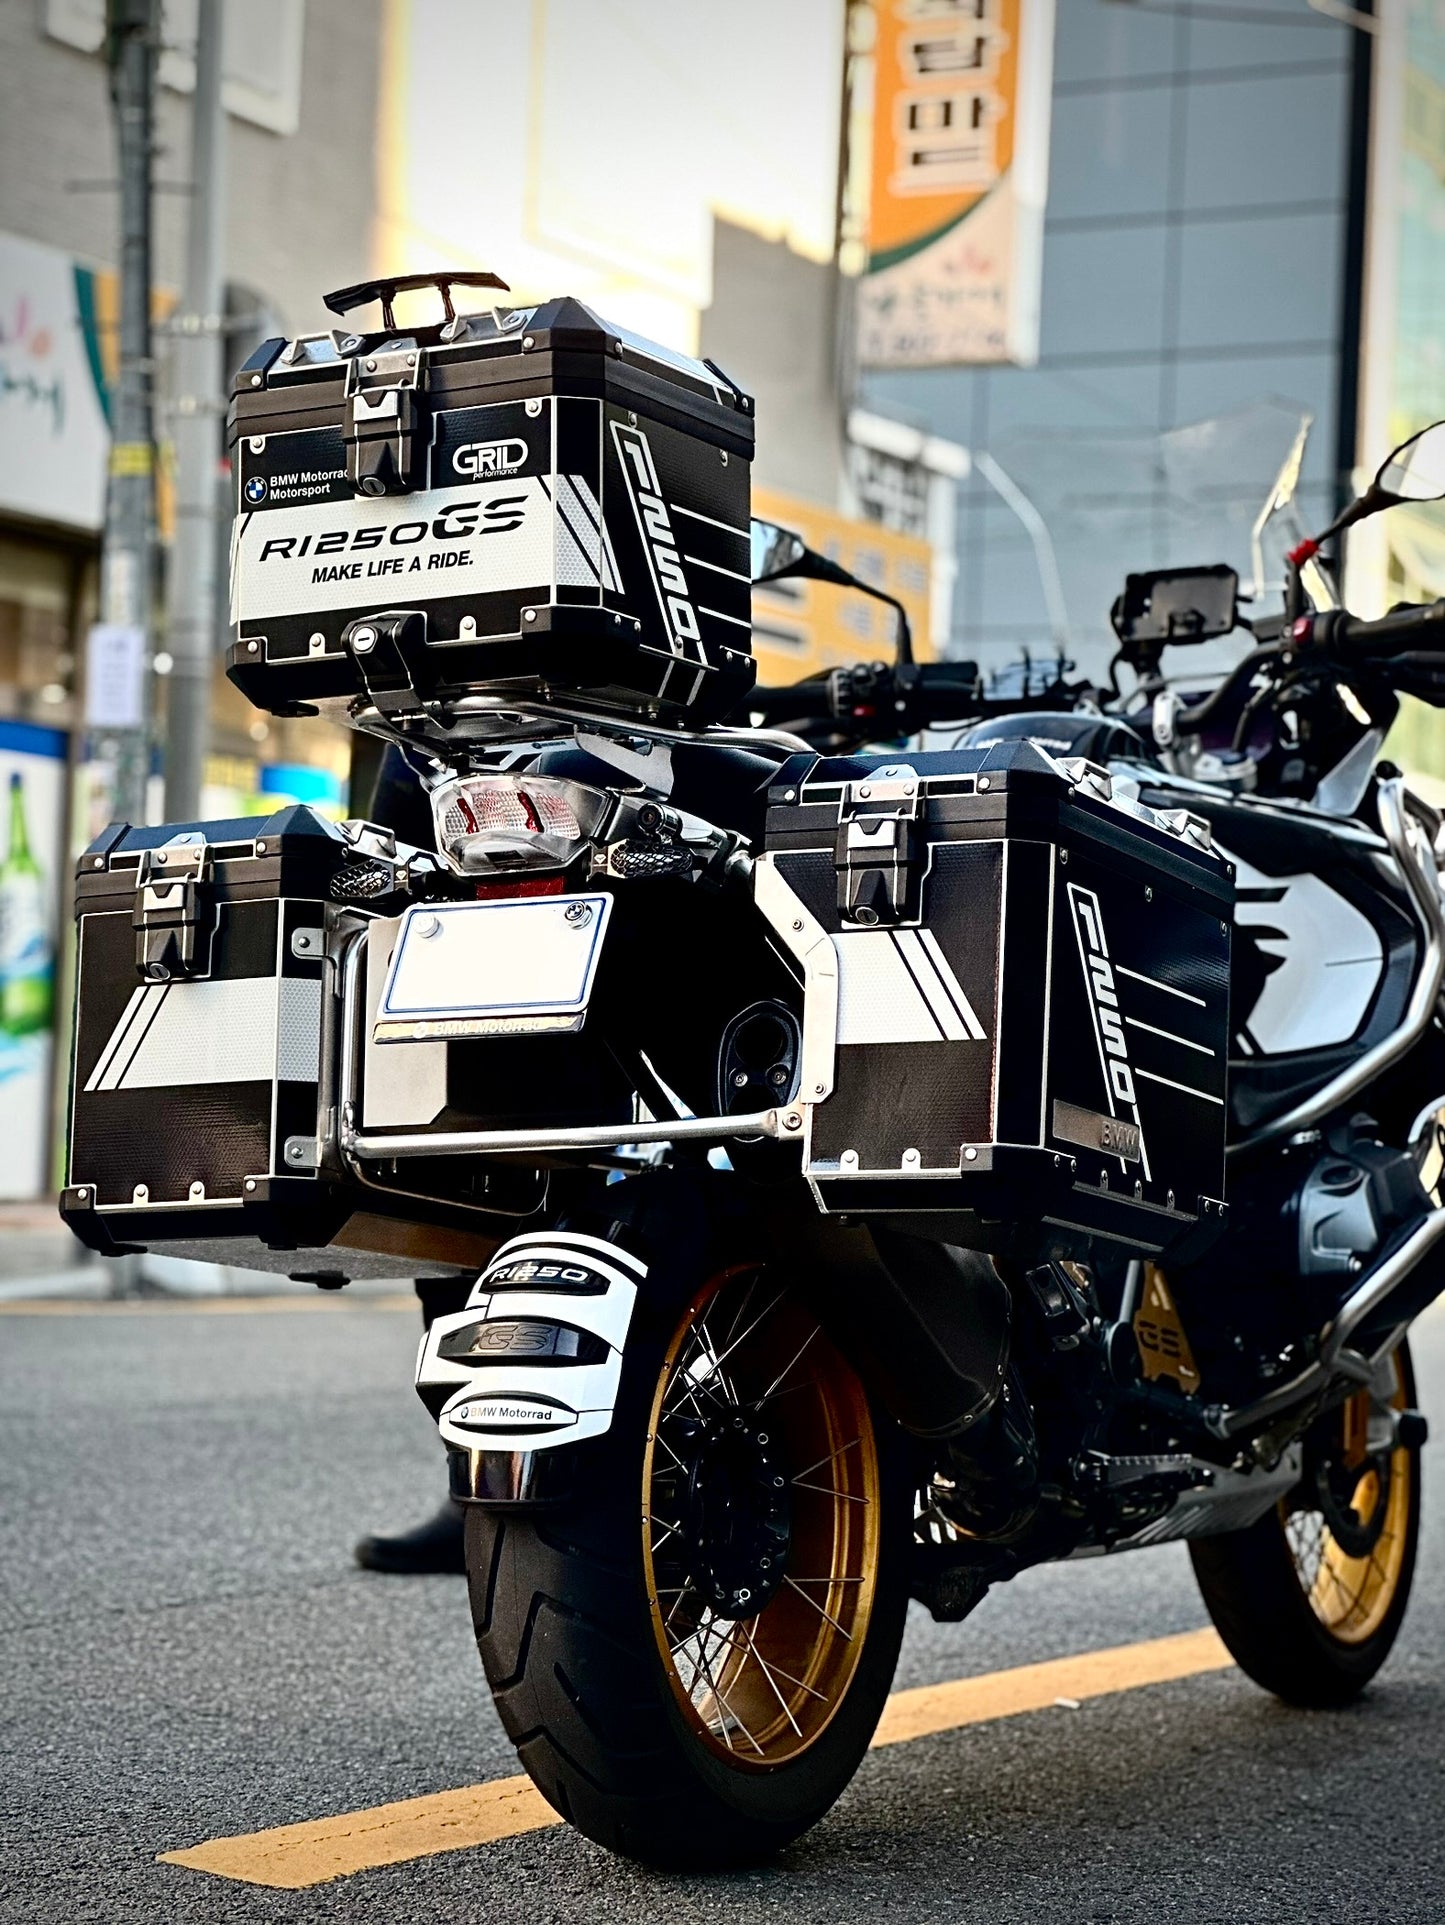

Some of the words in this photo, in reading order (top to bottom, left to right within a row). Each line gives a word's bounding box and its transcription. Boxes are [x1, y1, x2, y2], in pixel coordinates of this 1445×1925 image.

[452, 438, 529, 474] GRID
[270, 473, 299, 487] BMW
[473, 467, 518, 481] performance
[270, 482, 331, 500] Motorsport
[623, 440, 701, 641] 1250
[312, 564, 363, 583] MAKE
[368, 557, 405, 577] LIFE
[408, 556, 422, 573] A
[428, 550, 474, 570] RIDE.
[1078, 901, 1136, 1104] 1250
[434, 1021, 472, 1036] BMW
[479, 1018, 541, 1034] Motorrad
[1101, 1120, 1137, 1155] BMW
[489, 1265, 589, 1283] R1250
[478, 1325, 552, 1351] GS
[470, 1406, 497, 1417] BMW
[499, 1406, 553, 1421] Motorrad
